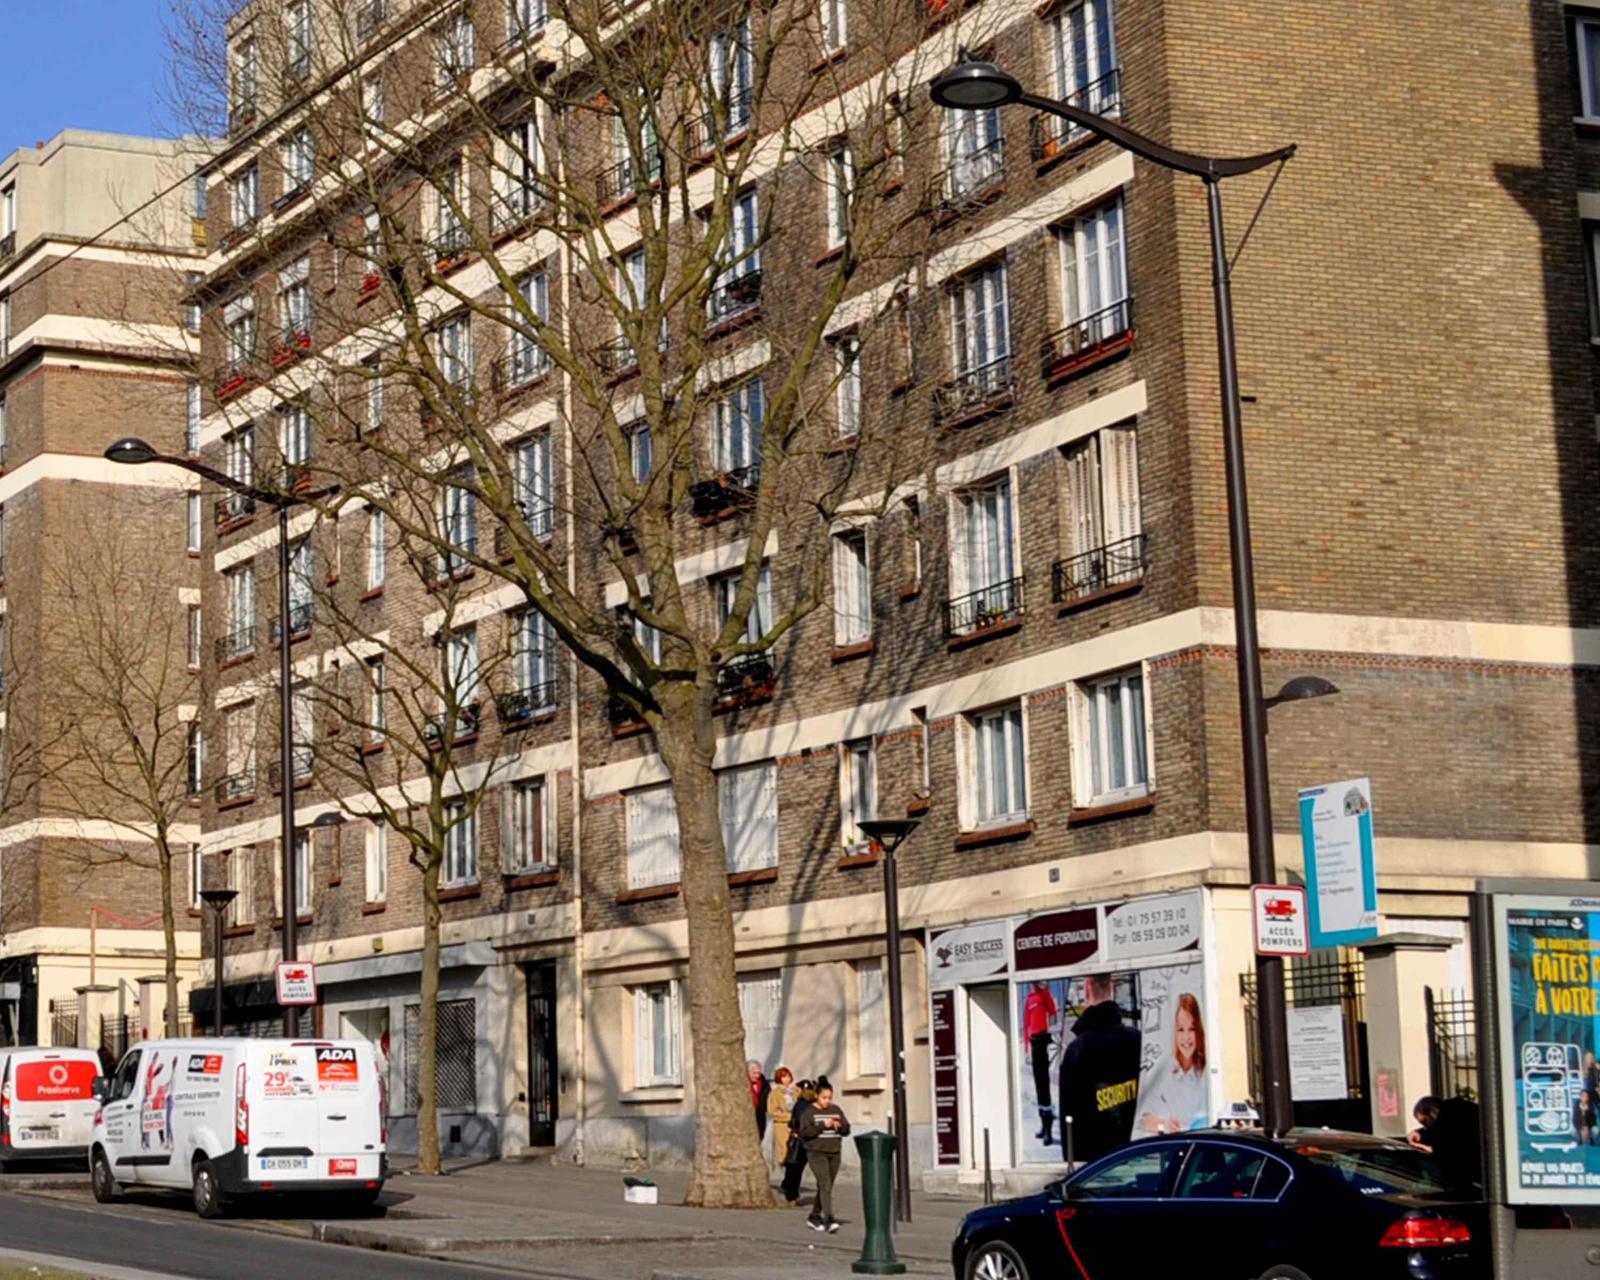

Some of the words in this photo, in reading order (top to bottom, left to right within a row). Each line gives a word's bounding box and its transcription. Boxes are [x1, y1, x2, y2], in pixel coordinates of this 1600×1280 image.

[1535, 918, 1546, 926] DE
[1547, 918, 1568, 927] PARIS
[1268, 925, 1295, 936] ACCÈS
[1016, 933, 1042, 951] CENTRE
[1043, 932, 1054, 948] DE
[1054, 928, 1097, 946] FORMATION
[1261, 936, 1303, 947] POMPIERS
[954, 943, 972, 956] EASY
[973, 938, 1004, 953] SUCCESS
[1536, 982, 1548, 1015] À
[1550, 986, 1598, 1016] VOTRE
[319, 1049, 354, 1061] ADA
[37, 1085, 80, 1095] Proxiserve
[1095, 1079, 1137, 1112] SECURITY
